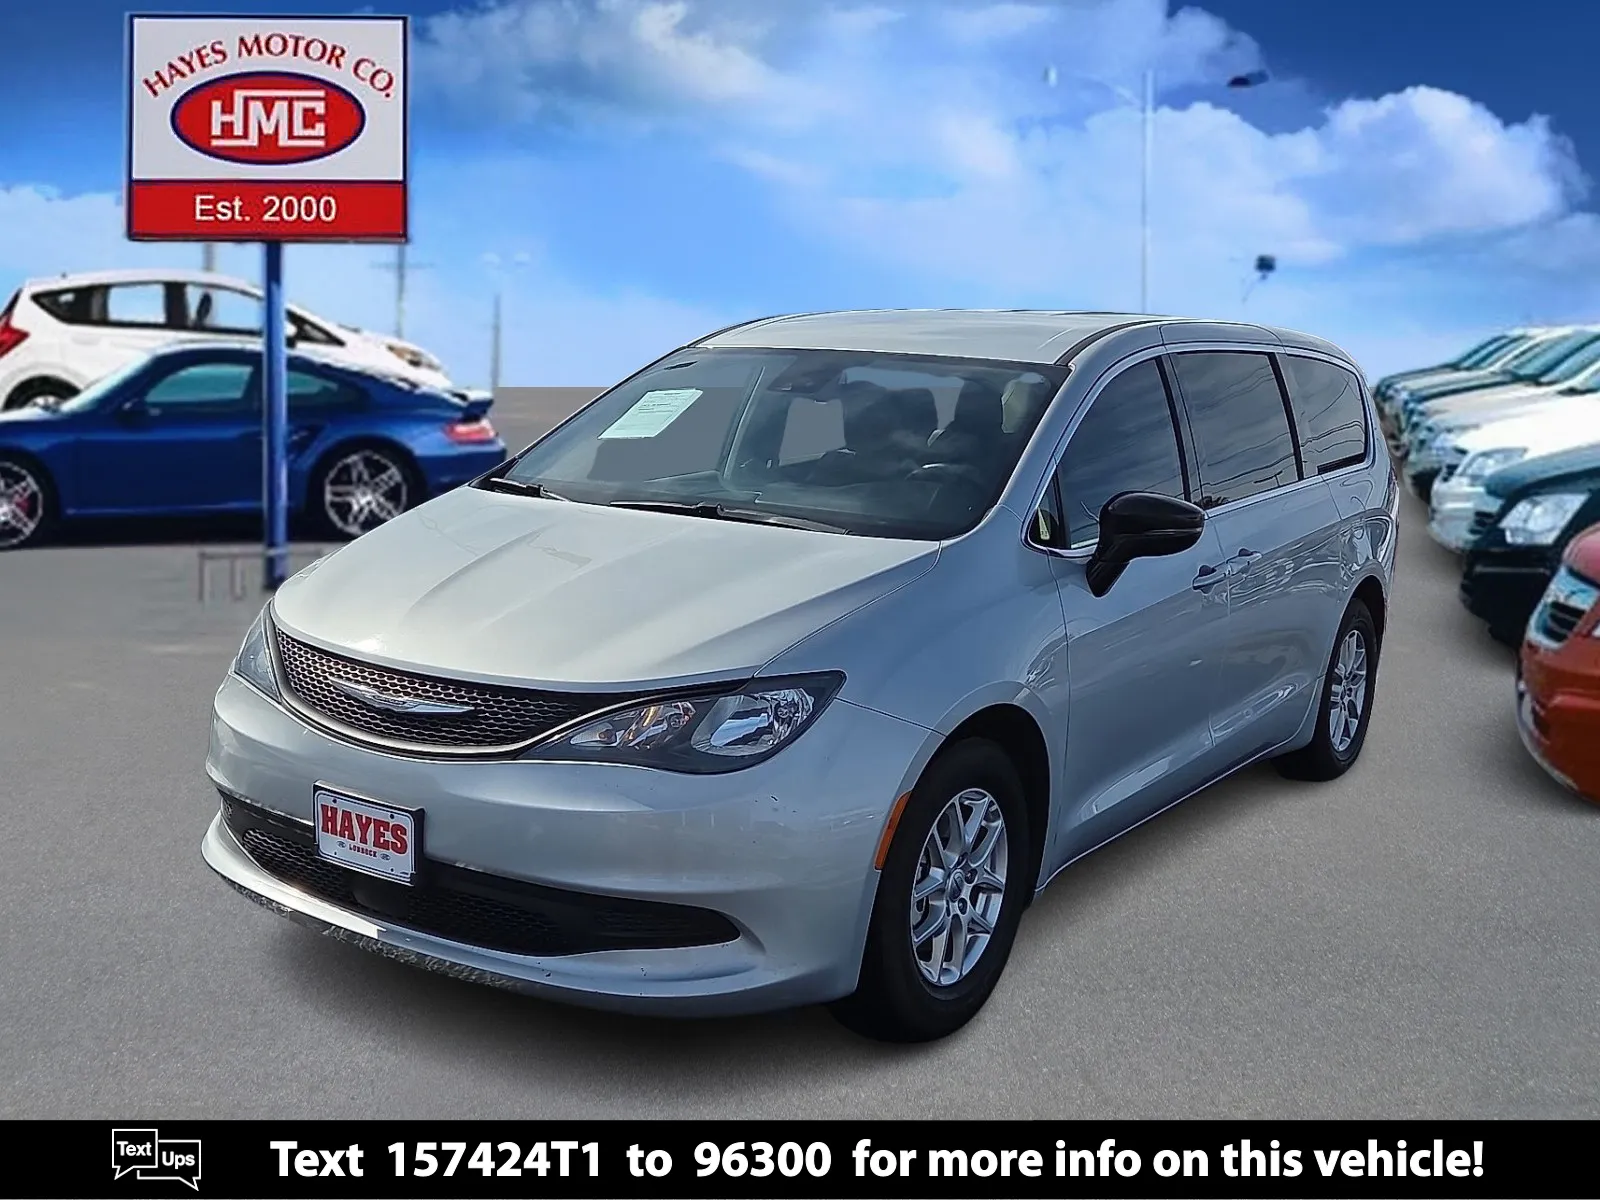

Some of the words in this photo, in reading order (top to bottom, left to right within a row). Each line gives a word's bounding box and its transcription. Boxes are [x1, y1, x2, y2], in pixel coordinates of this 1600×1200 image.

[143, 41, 228, 97] HAYES
[238, 33, 347, 70] MOTOR
[352, 57, 395, 98] CO.
[211, 89, 326, 147] HMC
[194, 195, 250, 222] Est.
[262, 195, 337, 222] 2000
[320, 803, 408, 855] HAYES
